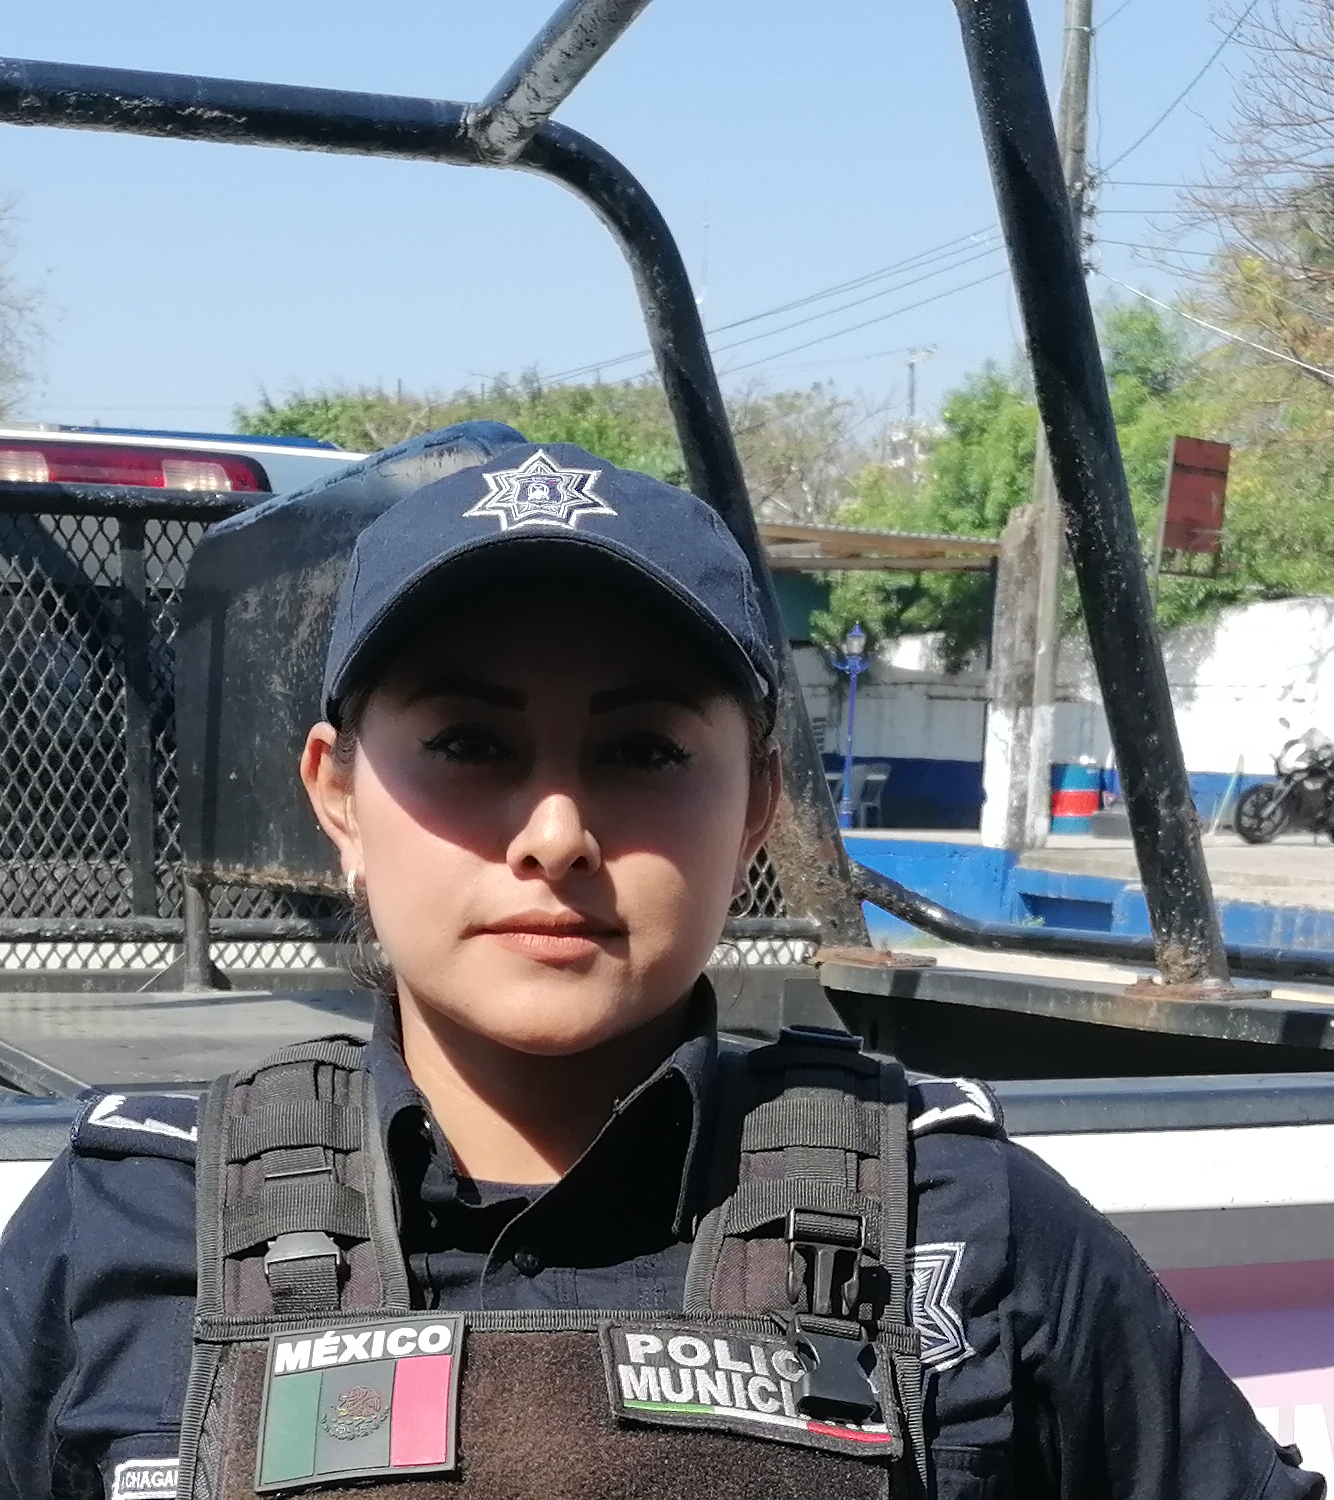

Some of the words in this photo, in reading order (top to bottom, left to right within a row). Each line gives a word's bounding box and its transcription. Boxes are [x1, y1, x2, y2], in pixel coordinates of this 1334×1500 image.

[274, 1324, 452, 1374] MÉXICO
[625, 1332, 807, 1383] POLIC
[618, 1364, 889, 1433] MUNICI
